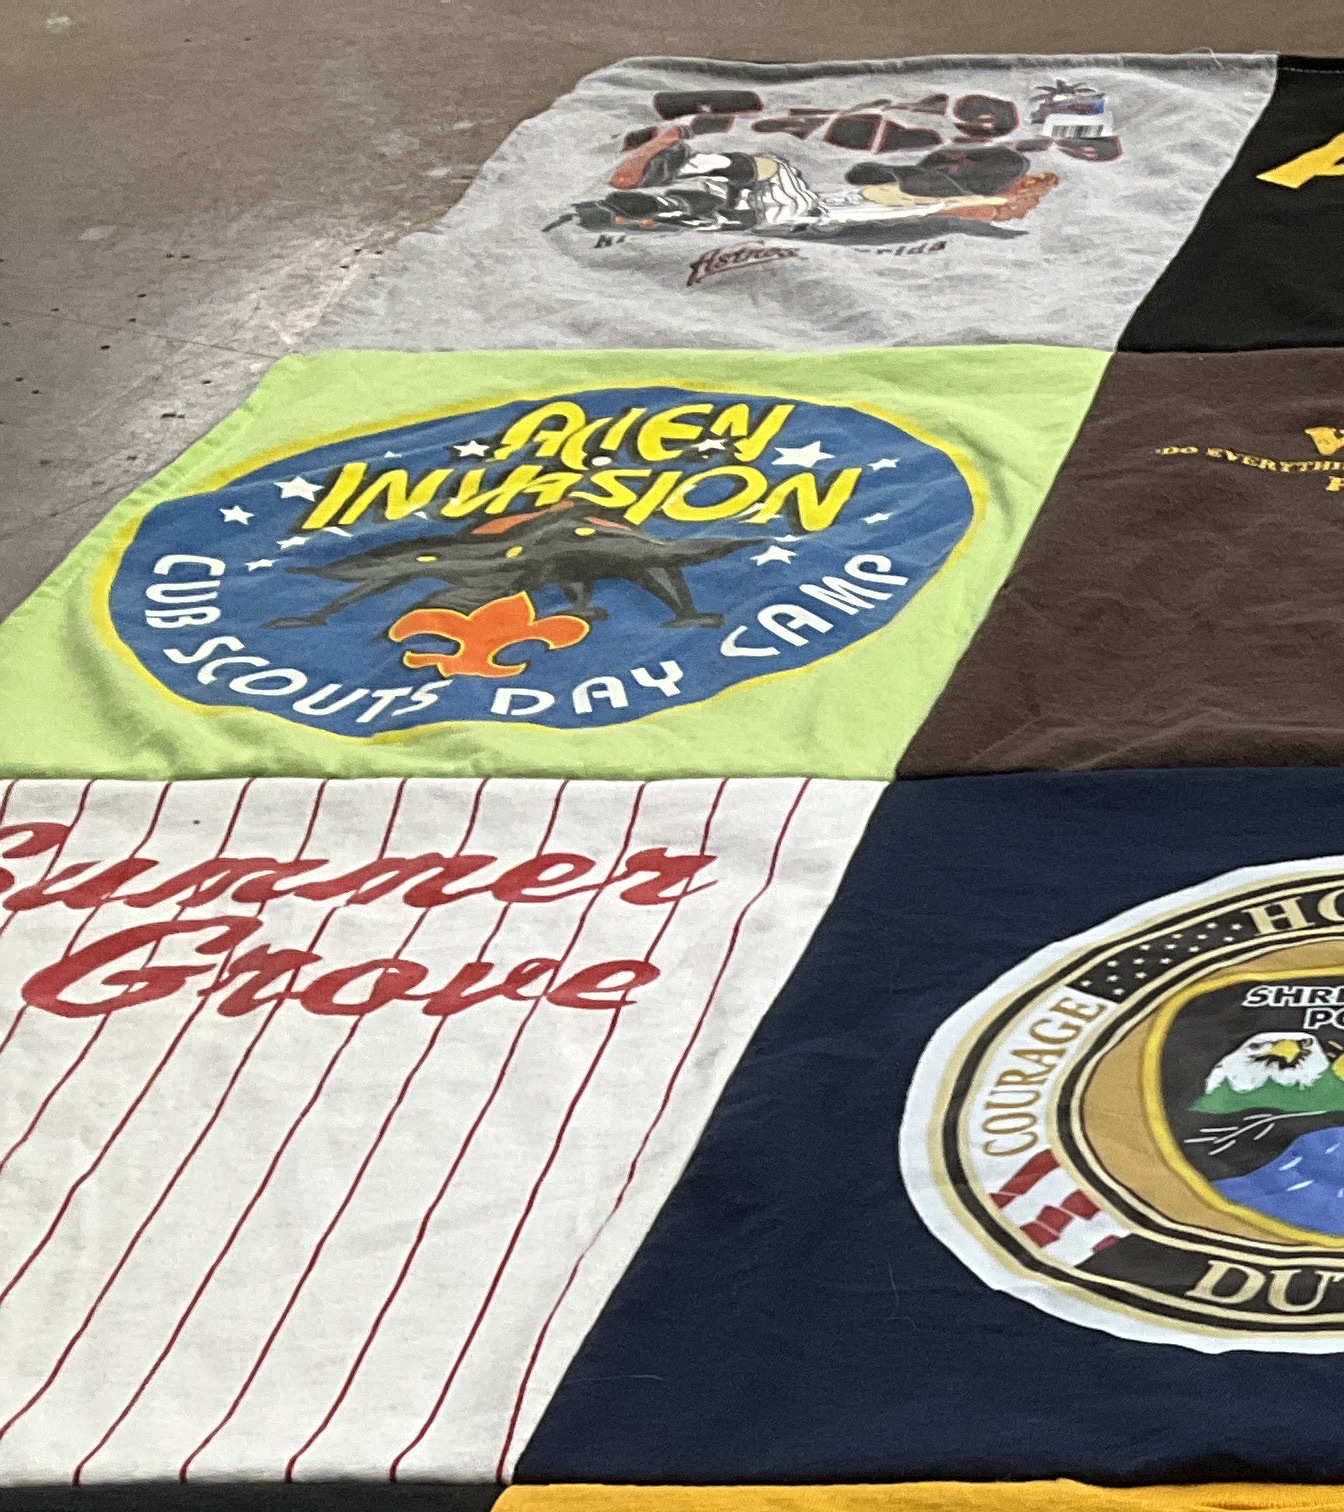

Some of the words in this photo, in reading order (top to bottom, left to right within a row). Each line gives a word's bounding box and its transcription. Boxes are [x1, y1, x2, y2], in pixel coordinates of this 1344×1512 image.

[496, 402, 795, 464] ALIEN
[299, 460, 863, 532] INVASION
[143, 553, 224, 630] CUB
[718, 551, 912, 662] CAMP
[163, 635, 455, 727] SCOUTS
[490, 658, 683, 717] DAY
[21, 915, 661, 1018] Grove
[982, 996, 1108, 1158] COURAGE
